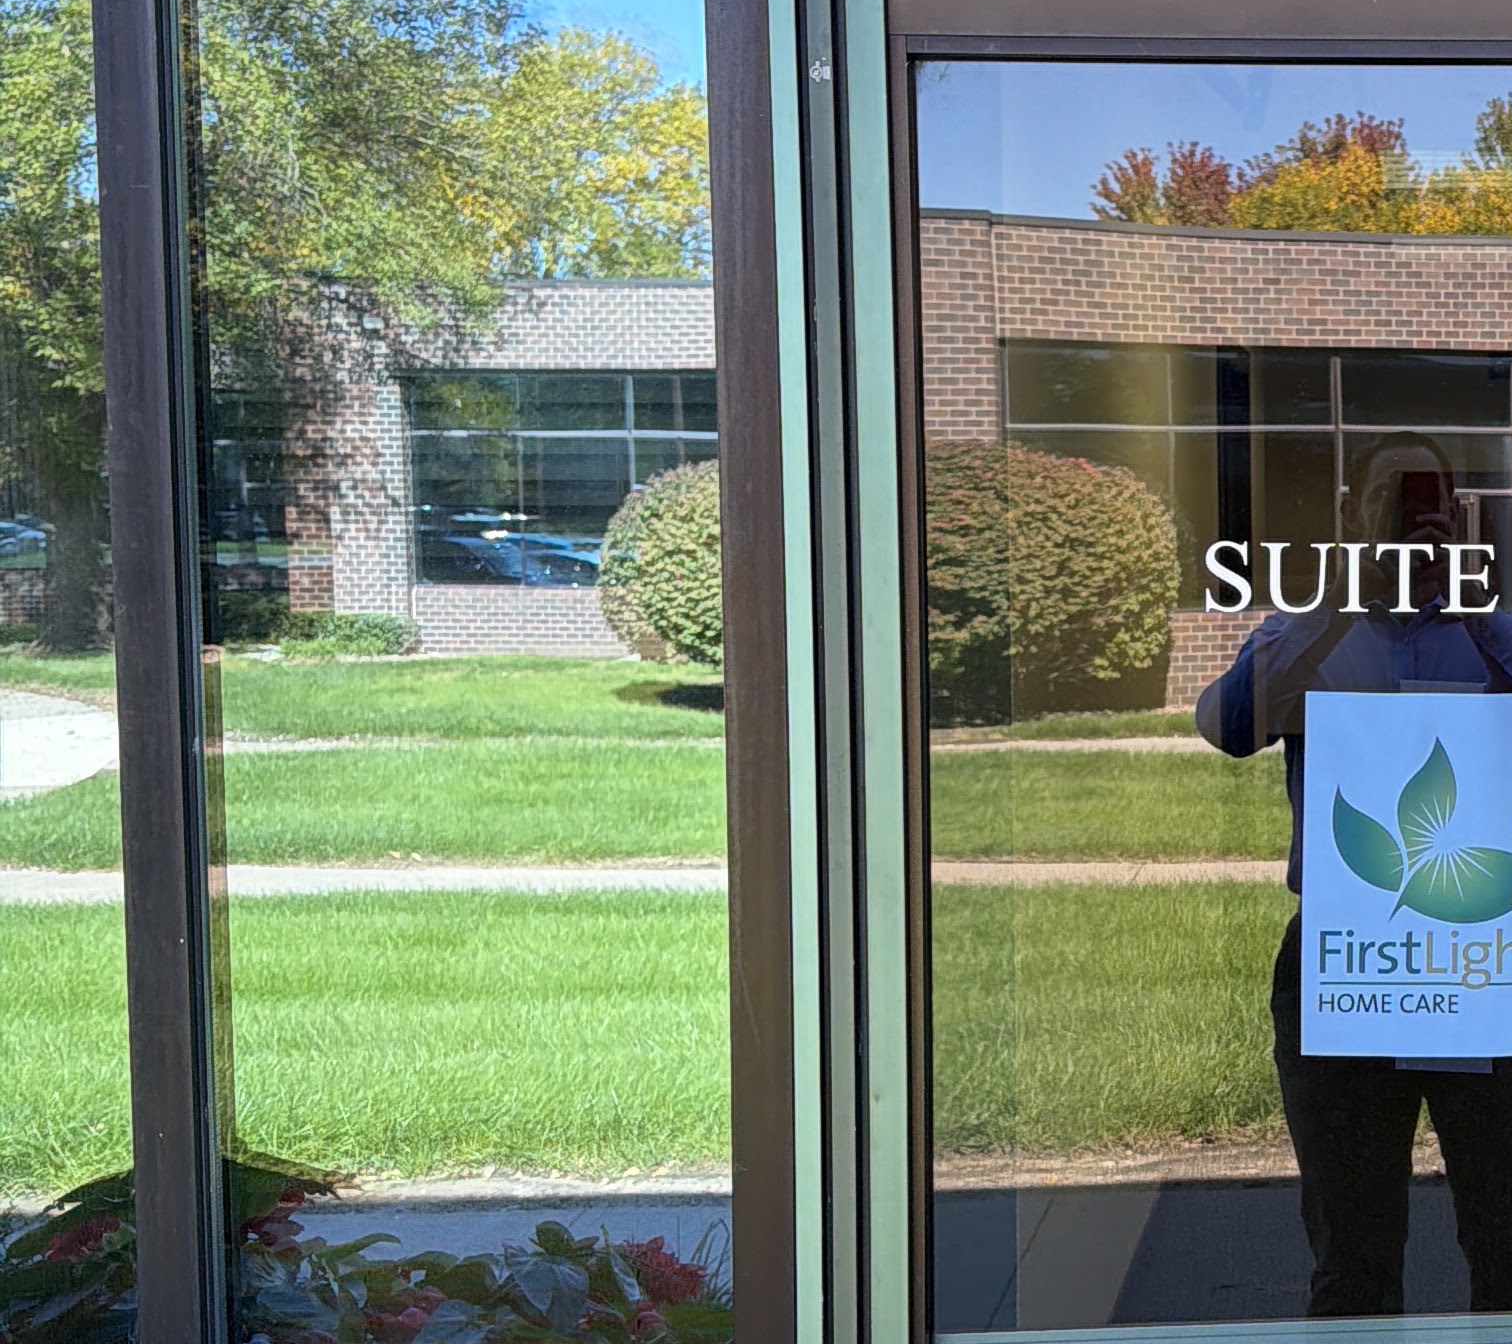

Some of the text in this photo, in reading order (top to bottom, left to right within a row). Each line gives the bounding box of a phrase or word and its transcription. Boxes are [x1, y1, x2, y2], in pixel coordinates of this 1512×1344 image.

[1205, 540, 1500, 613] SUITE
[1318, 993, 1459, 1014] HOME CARE
